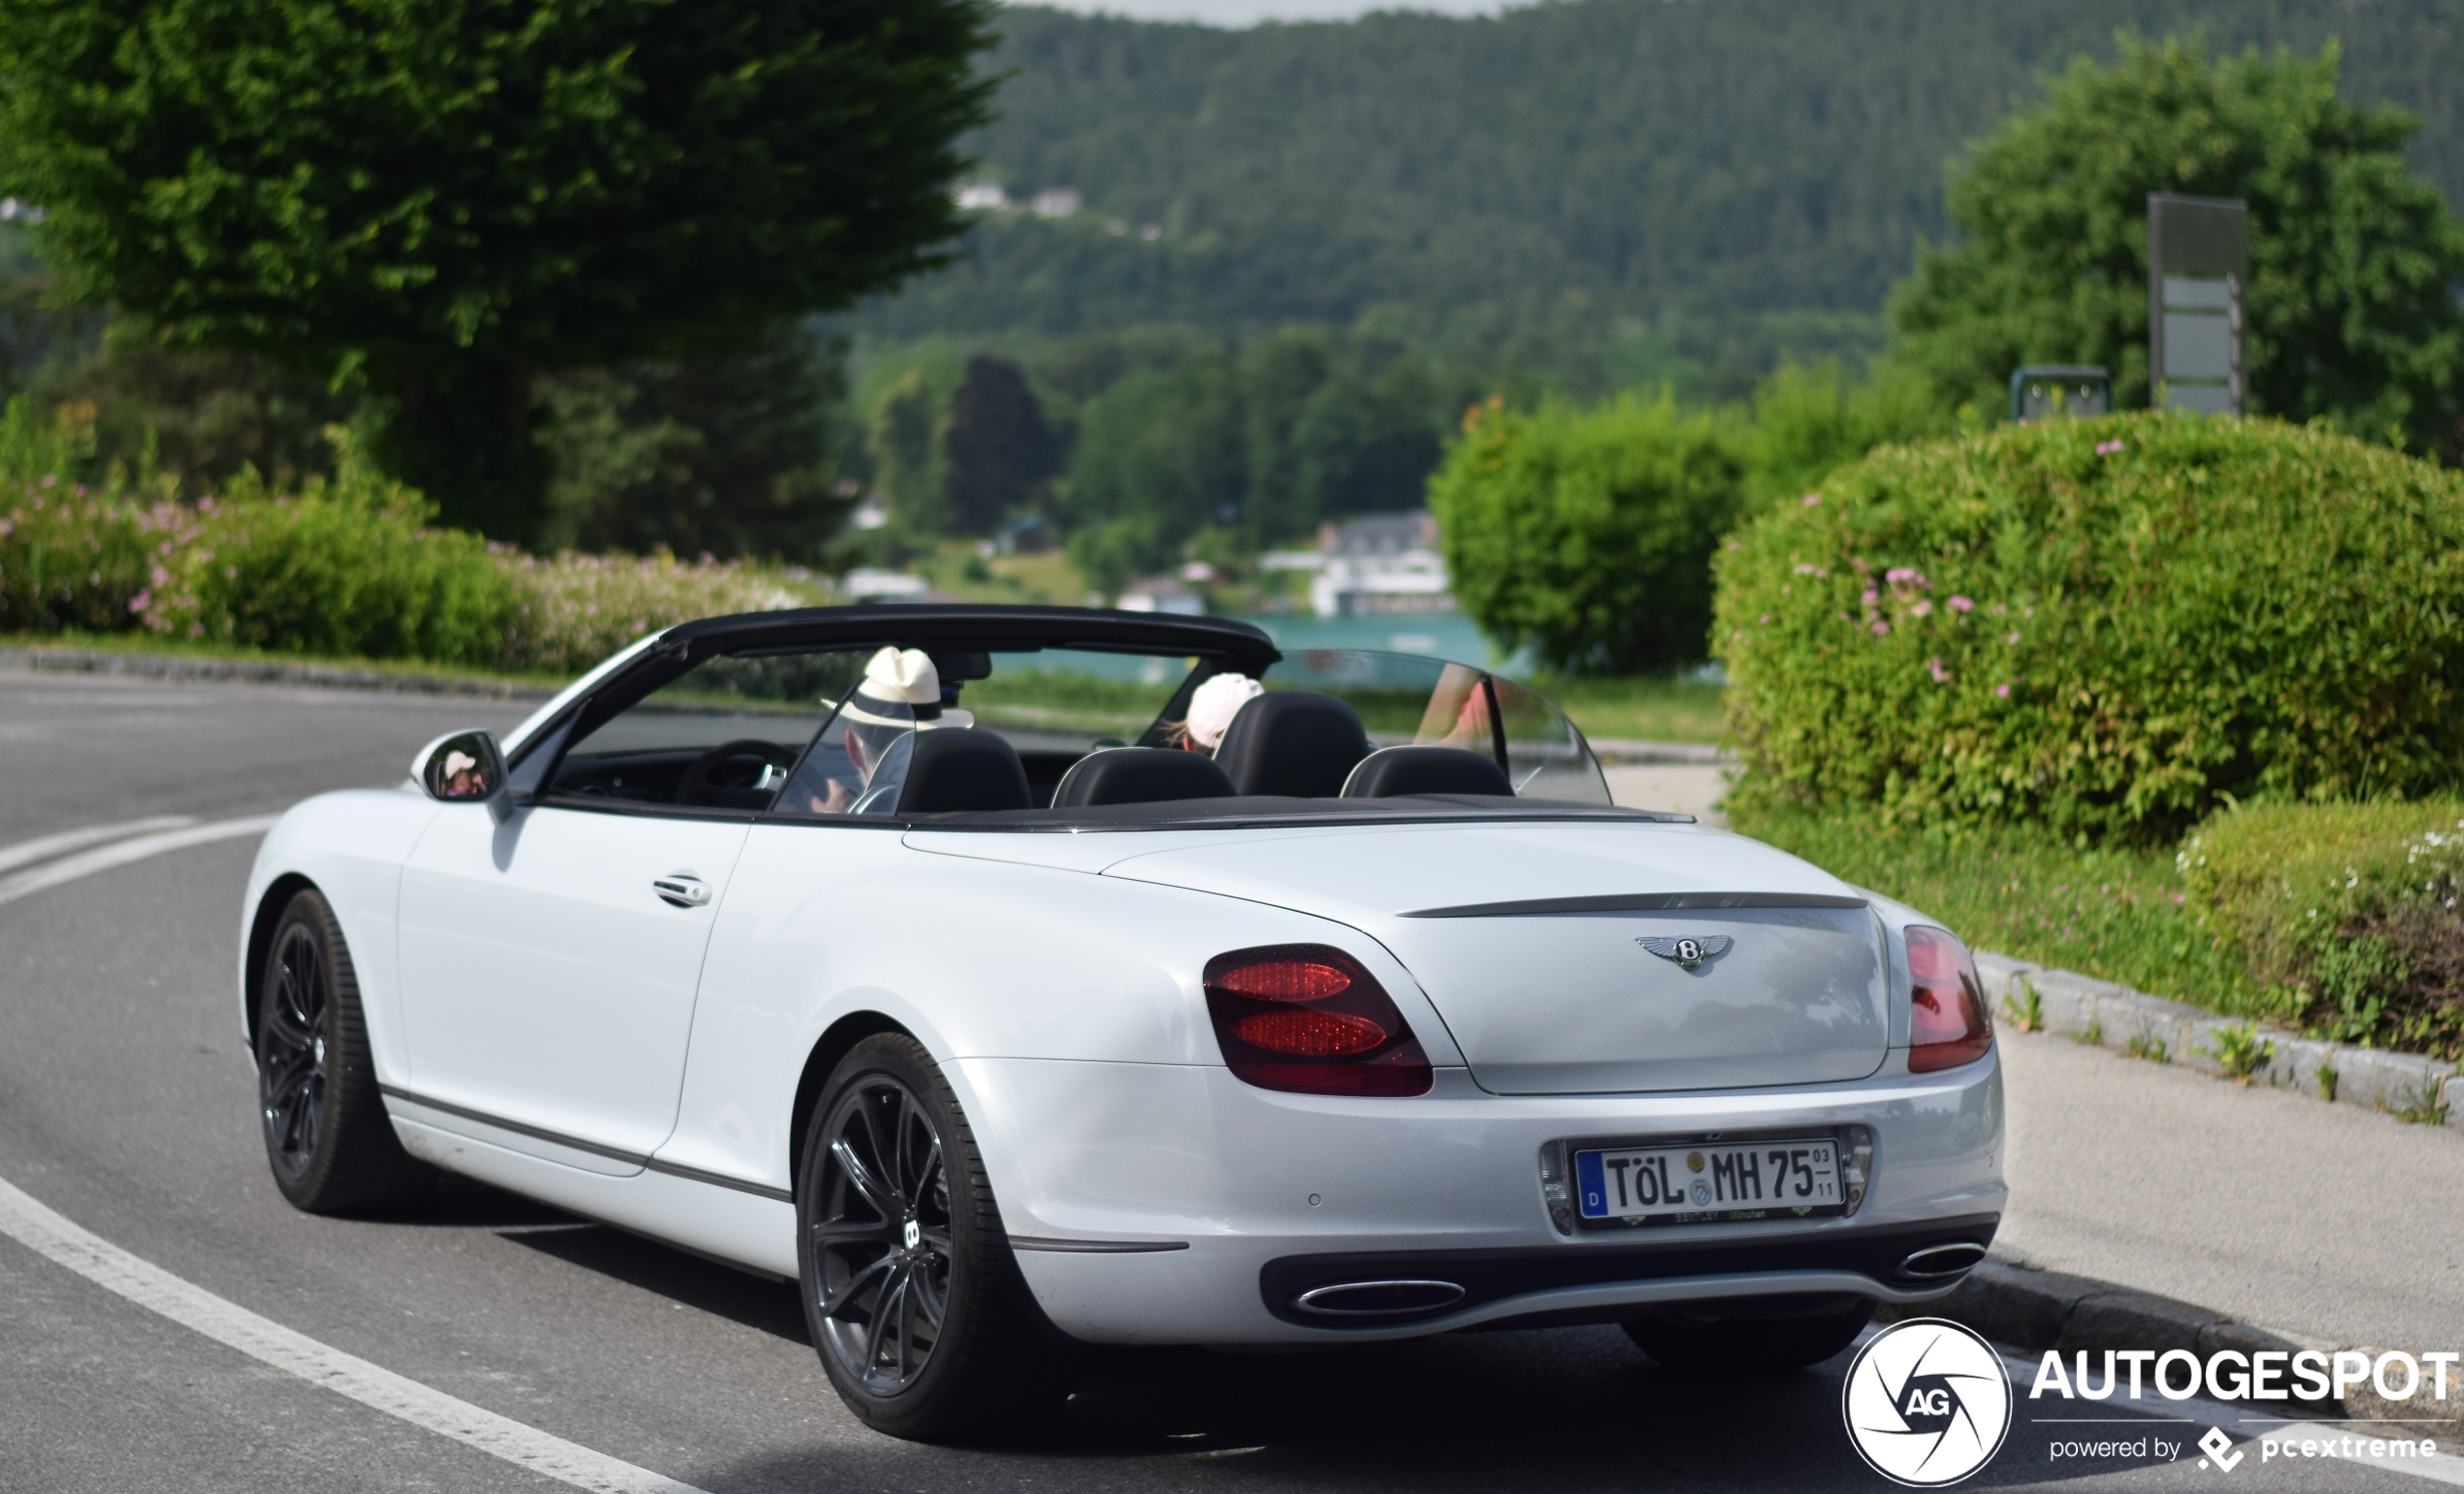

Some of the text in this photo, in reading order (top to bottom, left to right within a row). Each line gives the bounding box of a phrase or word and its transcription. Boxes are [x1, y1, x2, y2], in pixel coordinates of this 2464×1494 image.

[1679, 939, 1699, 959] B
[1813, 1149, 1830, 1162] 03
[1606, 1150, 1814, 1207] TÖL MH 75
[1818, 1183, 1832, 1196] 11
[1589, 1192, 1600, 1207] D
[1675, 1210, 1719, 1223] BENTLEY
[904, 1219, 920, 1250] B
